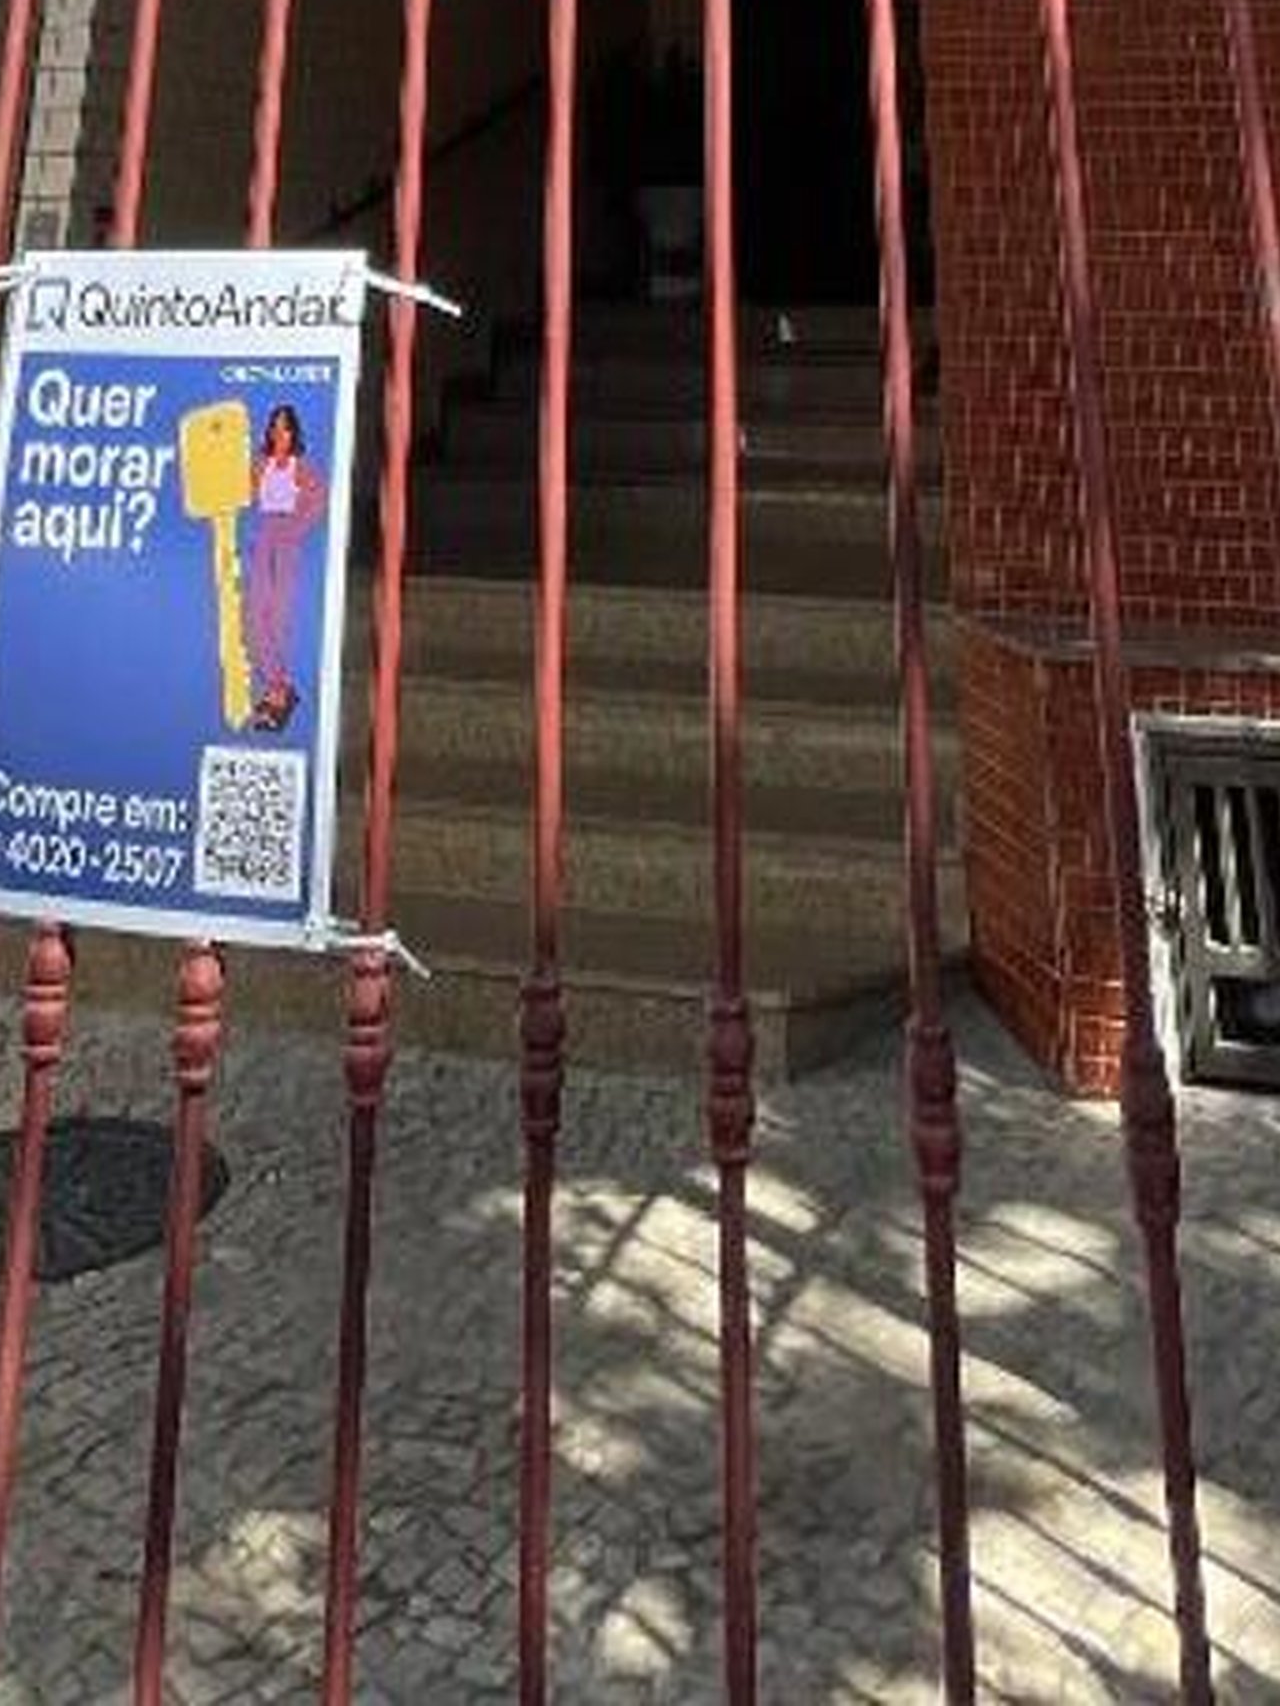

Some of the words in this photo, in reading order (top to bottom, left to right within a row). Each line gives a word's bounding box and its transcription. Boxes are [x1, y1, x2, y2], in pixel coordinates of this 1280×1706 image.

[78, 282, 347, 329] QuintoAndar
[28, 368, 158, 429] Quer
[21, 441, 176, 488] morar
[13, 491, 157, 561] aqui?
[124, 795, 188, 833] em:
